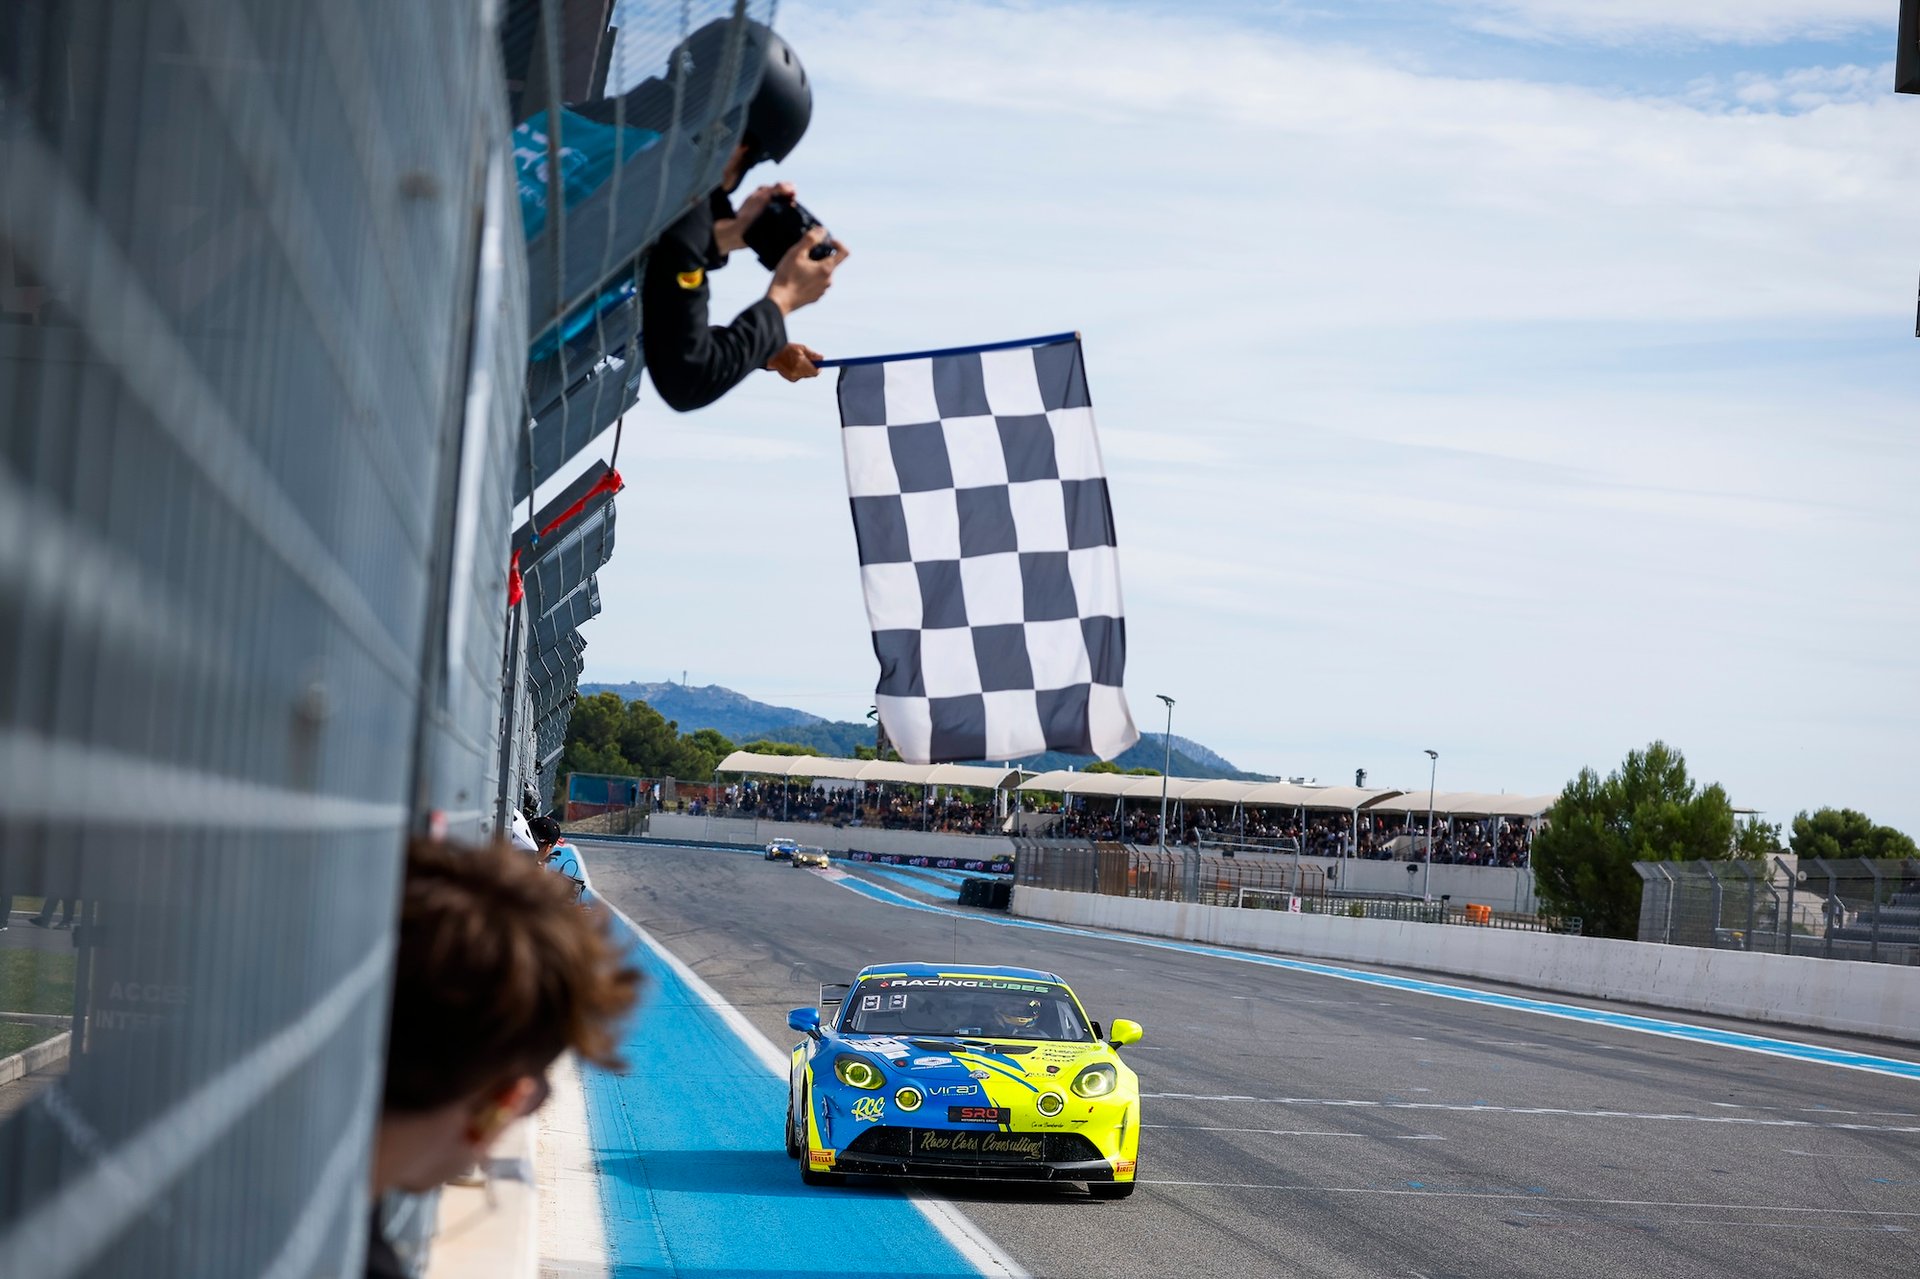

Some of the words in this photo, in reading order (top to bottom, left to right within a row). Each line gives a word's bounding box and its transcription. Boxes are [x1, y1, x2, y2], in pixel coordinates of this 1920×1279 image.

[992, 864, 1004, 872] elf
[961, 1108, 998, 1118] SRO
[920, 1131, 950, 1150] Race
[952, 1132, 978, 1150] Cars
[982, 1133, 1041, 1159] Consulting
